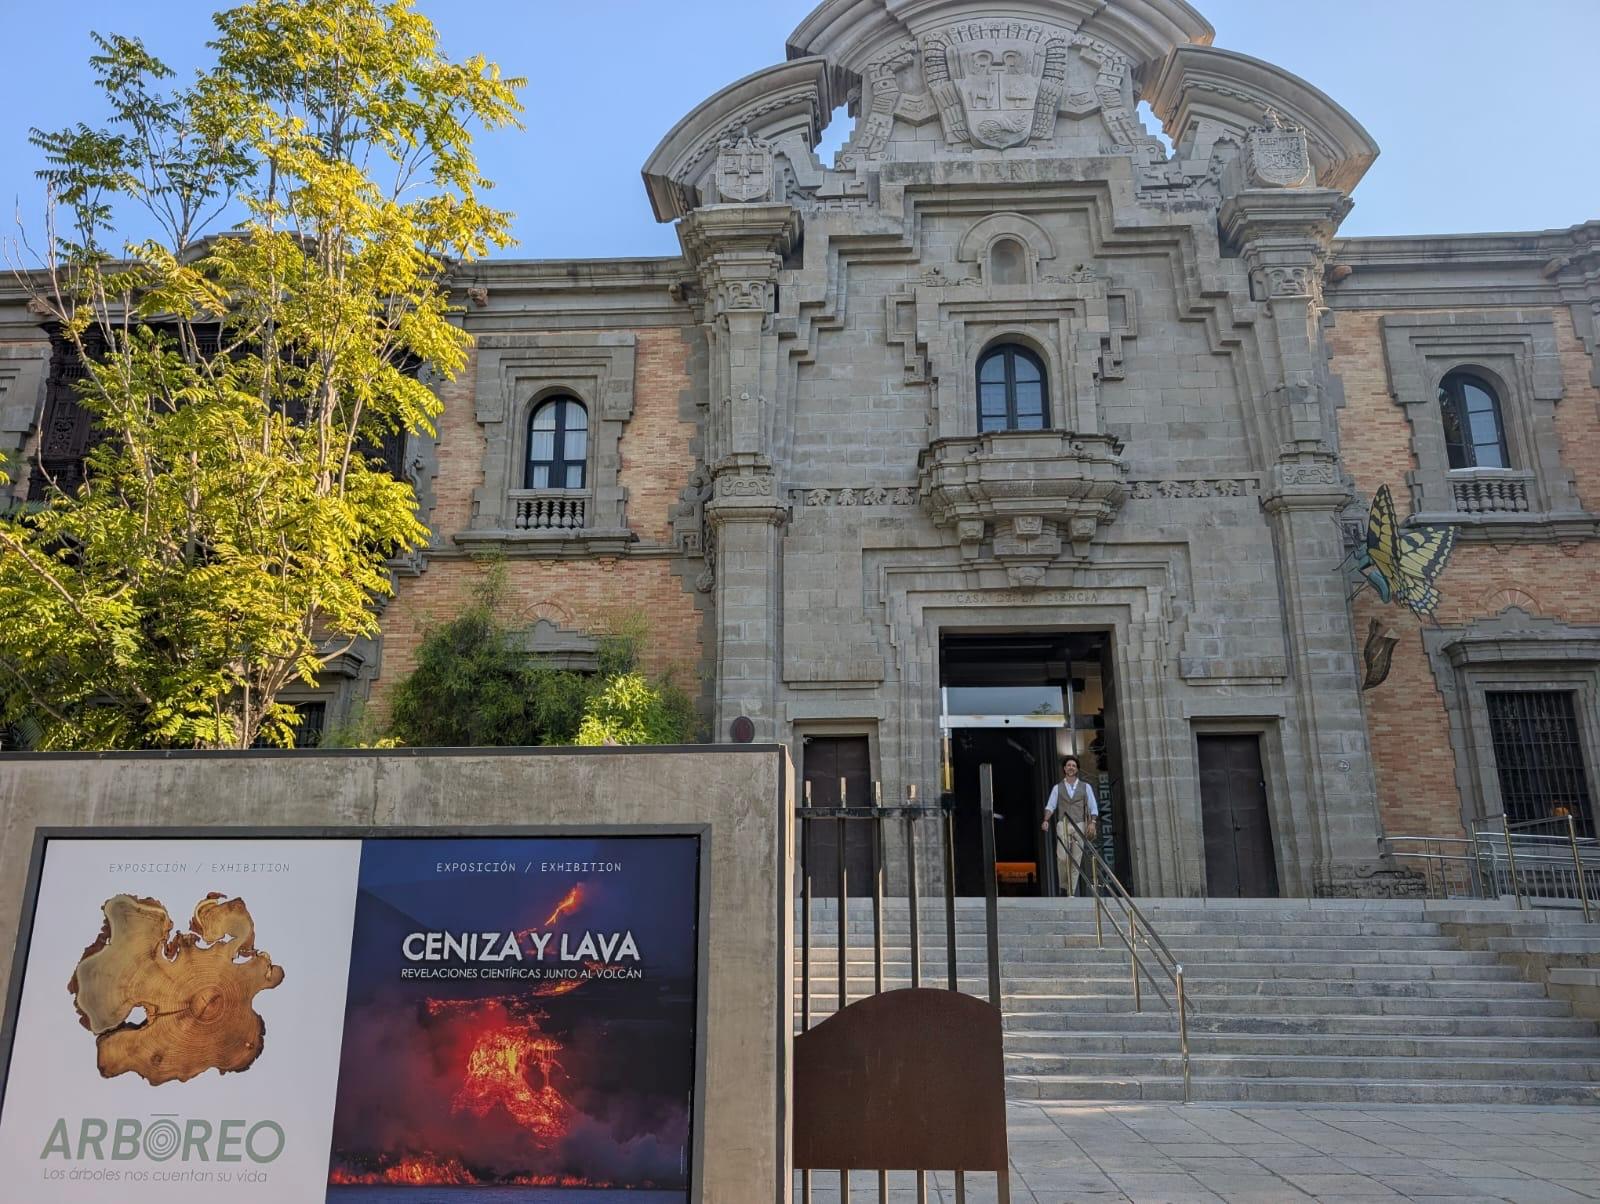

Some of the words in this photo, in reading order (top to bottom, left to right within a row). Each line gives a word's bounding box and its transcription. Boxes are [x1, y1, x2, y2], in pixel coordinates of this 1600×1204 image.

[109, 862, 187, 873] EXPOSICIÓN
[211, 863, 290, 873] EXHIBITION
[436, 861, 516, 872] EXPOSICIÓN
[541, 862, 622, 872] EXHIBITION
[402, 931, 523, 963] CENIZA
[530, 933, 552, 960] Y
[560, 930, 641, 963] LAVA
[401, 968, 477, 979] REVELACIONES
[480, 966, 541, 979] CIENTÍFICAS
[543, 968, 577, 979] JUNTO
[580, 968, 592, 979] AL
[597, 966, 642, 979] VOLCÁN
[43, 1168, 65, 1180] Los
[69, 1167, 121, 1182] árboles
[124, 1170, 149, 1181] nos
[152, 1169, 213, 1182] cuentan
[217, 1171, 232, 1182] su
[237, 1169, 268, 1183] vida
